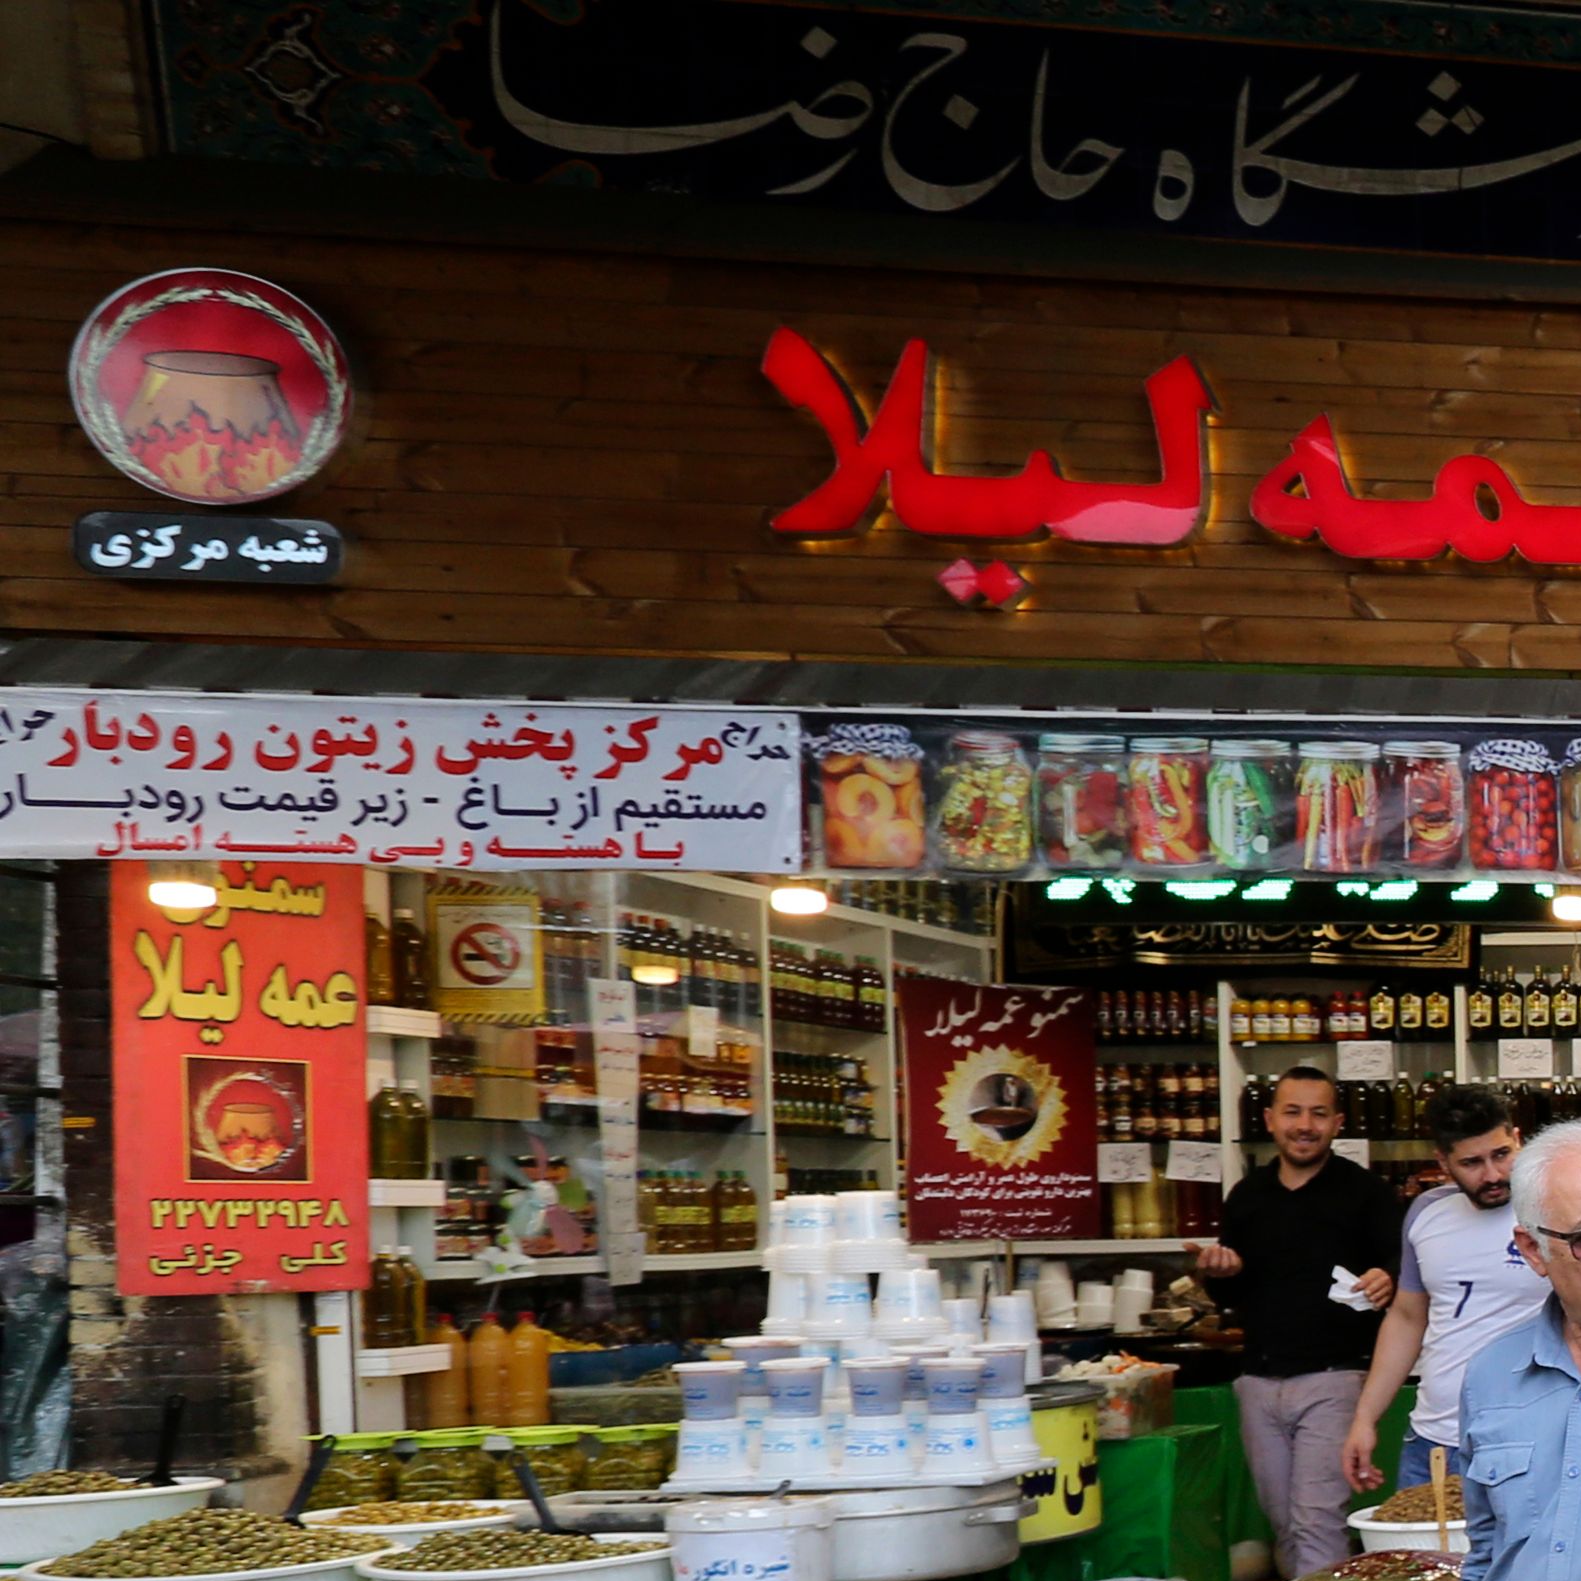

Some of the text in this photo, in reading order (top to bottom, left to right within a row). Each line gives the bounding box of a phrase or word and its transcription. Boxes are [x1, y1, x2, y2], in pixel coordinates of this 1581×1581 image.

[490, 0, 875, 196] رضا
[883, 30, 1124, 212] حاج
[761, 325, 1212, 605] لیلا
[88, 526, 330, 576] شعبه مرکزی
[47, 701, 235, 770] رودبار
[254, 714, 415, 775] زیتون
[436, 712, 577, 780] پخش
[594, 715, 724, 781] مرکز
[218, 778, 339, 823] قیمت
[350, 787, 409, 827] زیر
[456, 777, 559, 830] باغ
[571, 784, 600, 830] از
[613, 789, 767, 831] مستقیم
[96, 821, 685, 866] با هسته و بی هسته امسال
[134, 929, 358, 1041] عمه لیلا
[924, 986, 1085, 1048] سمنو عمه لیلا
[150, 1198, 350, 1229] ۲۲۷۳۲۹۴۸
[279, 1241, 348, 1274] کلی
[1450, 1279, 1475, 1319] 7
[743, 1554, 791, 1580] شیره
